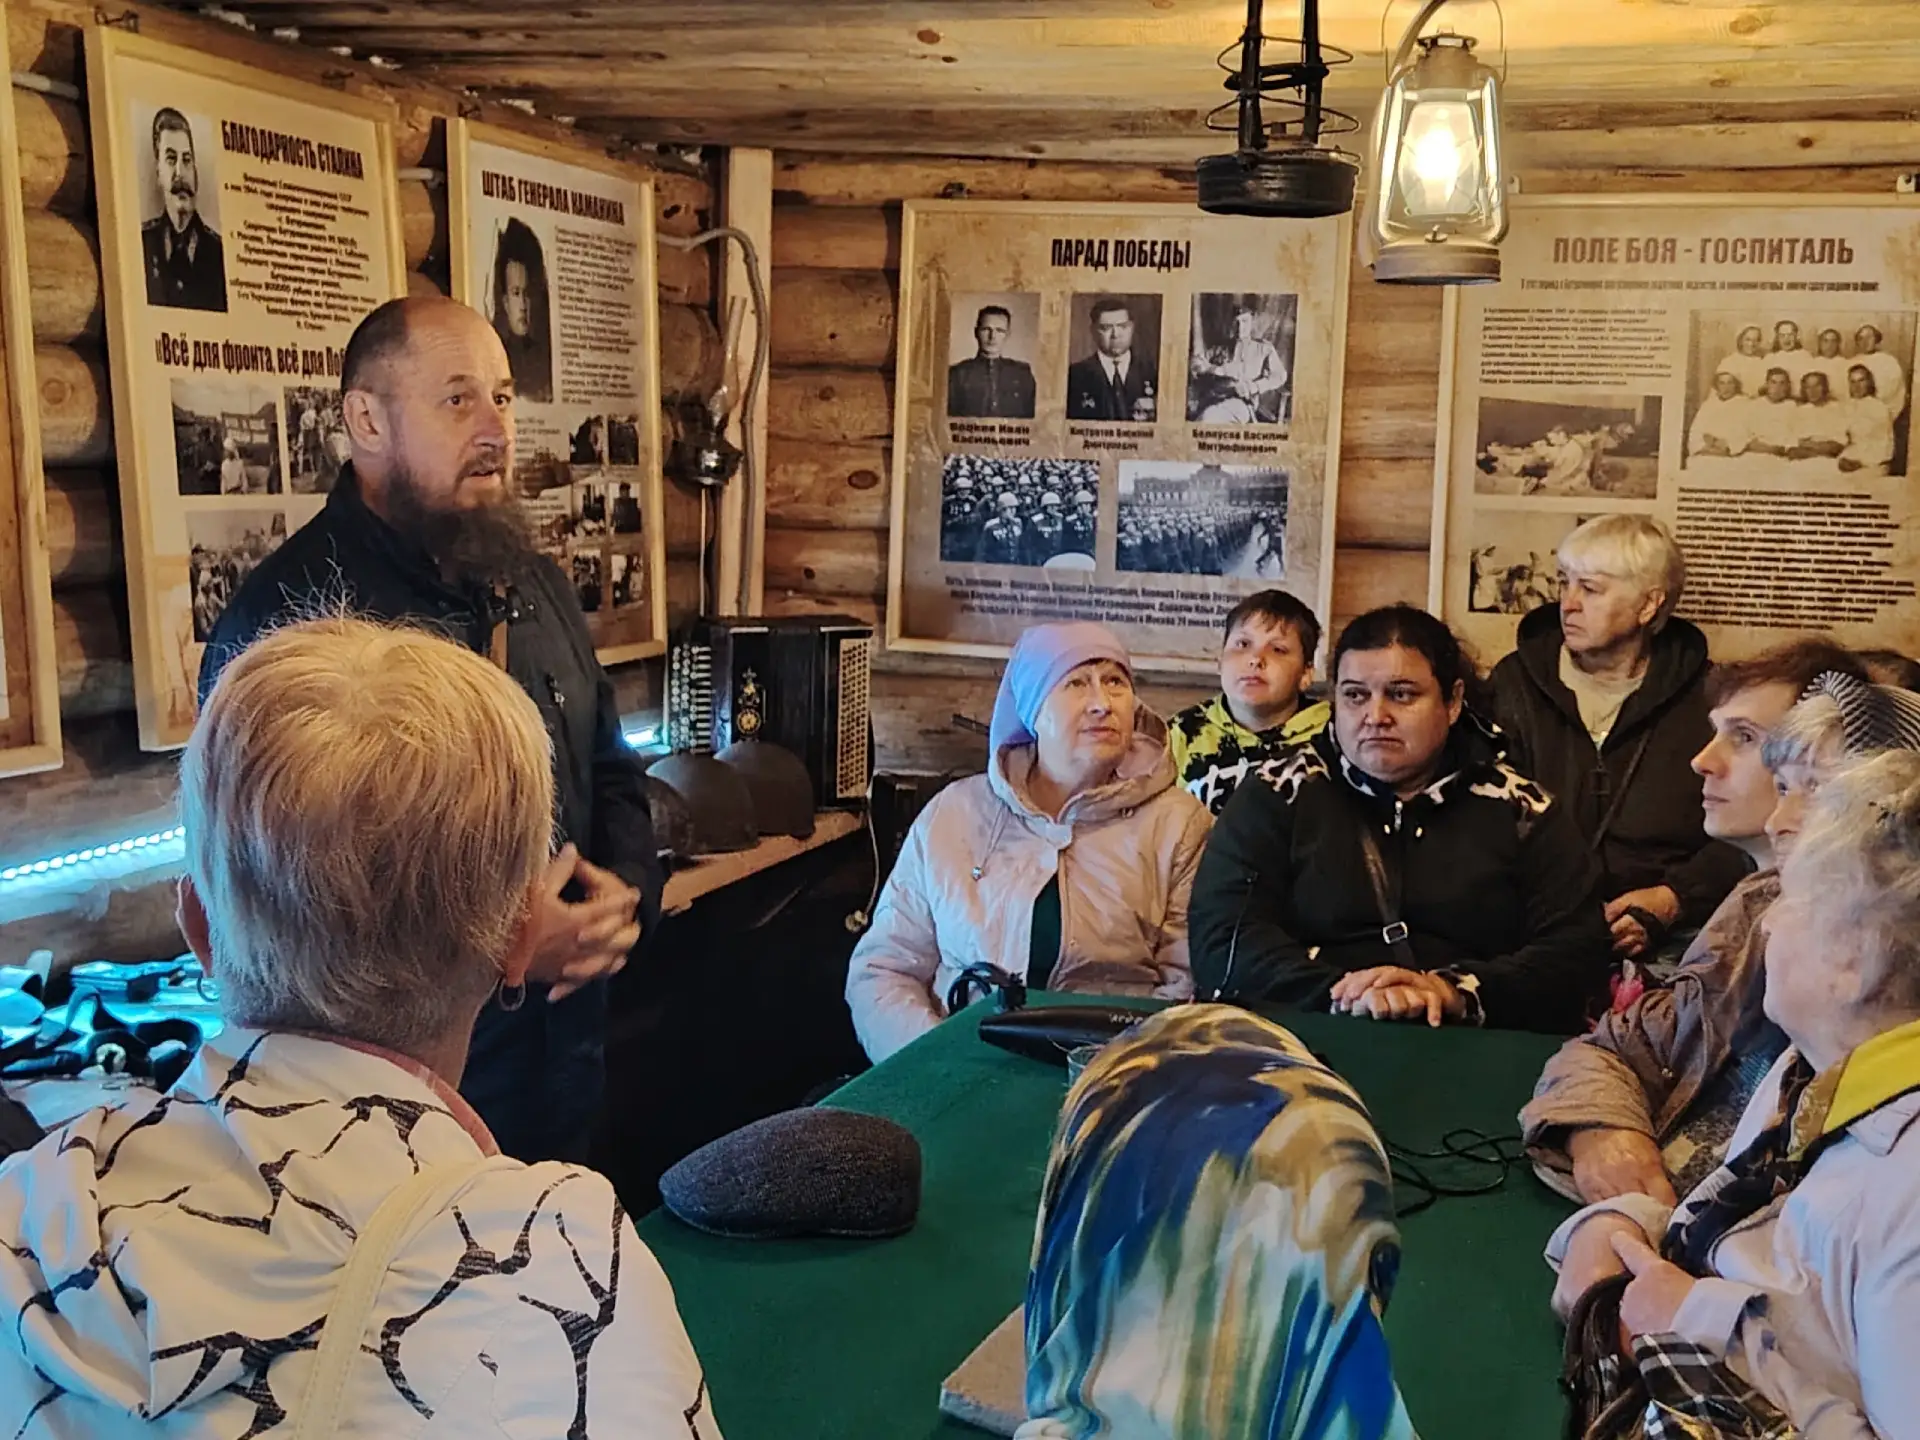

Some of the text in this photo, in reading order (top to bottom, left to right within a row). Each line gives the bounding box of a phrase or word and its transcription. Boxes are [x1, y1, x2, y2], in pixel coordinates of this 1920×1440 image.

[221, 119, 364, 181] БЛАГОДАРНОСТЬ СТАЛИНА
[481, 170, 625, 226] ШТАБ ГЕНЕРАЛА КАМАНИНА
[1051, 238, 1191, 273] ПАРАД ПОБЕДЫ
[1552, 237, 1620, 264] ПОЛЕ
[1625, 237, 1677, 264] БОЯ
[1699, 237, 1855, 265] ГОСПИТАЛЬ
[192, 340, 220, 373] для
[222, 339, 276, 376] фронта,
[277, 342, 299, 375] всё
[302, 349, 324, 380] для
